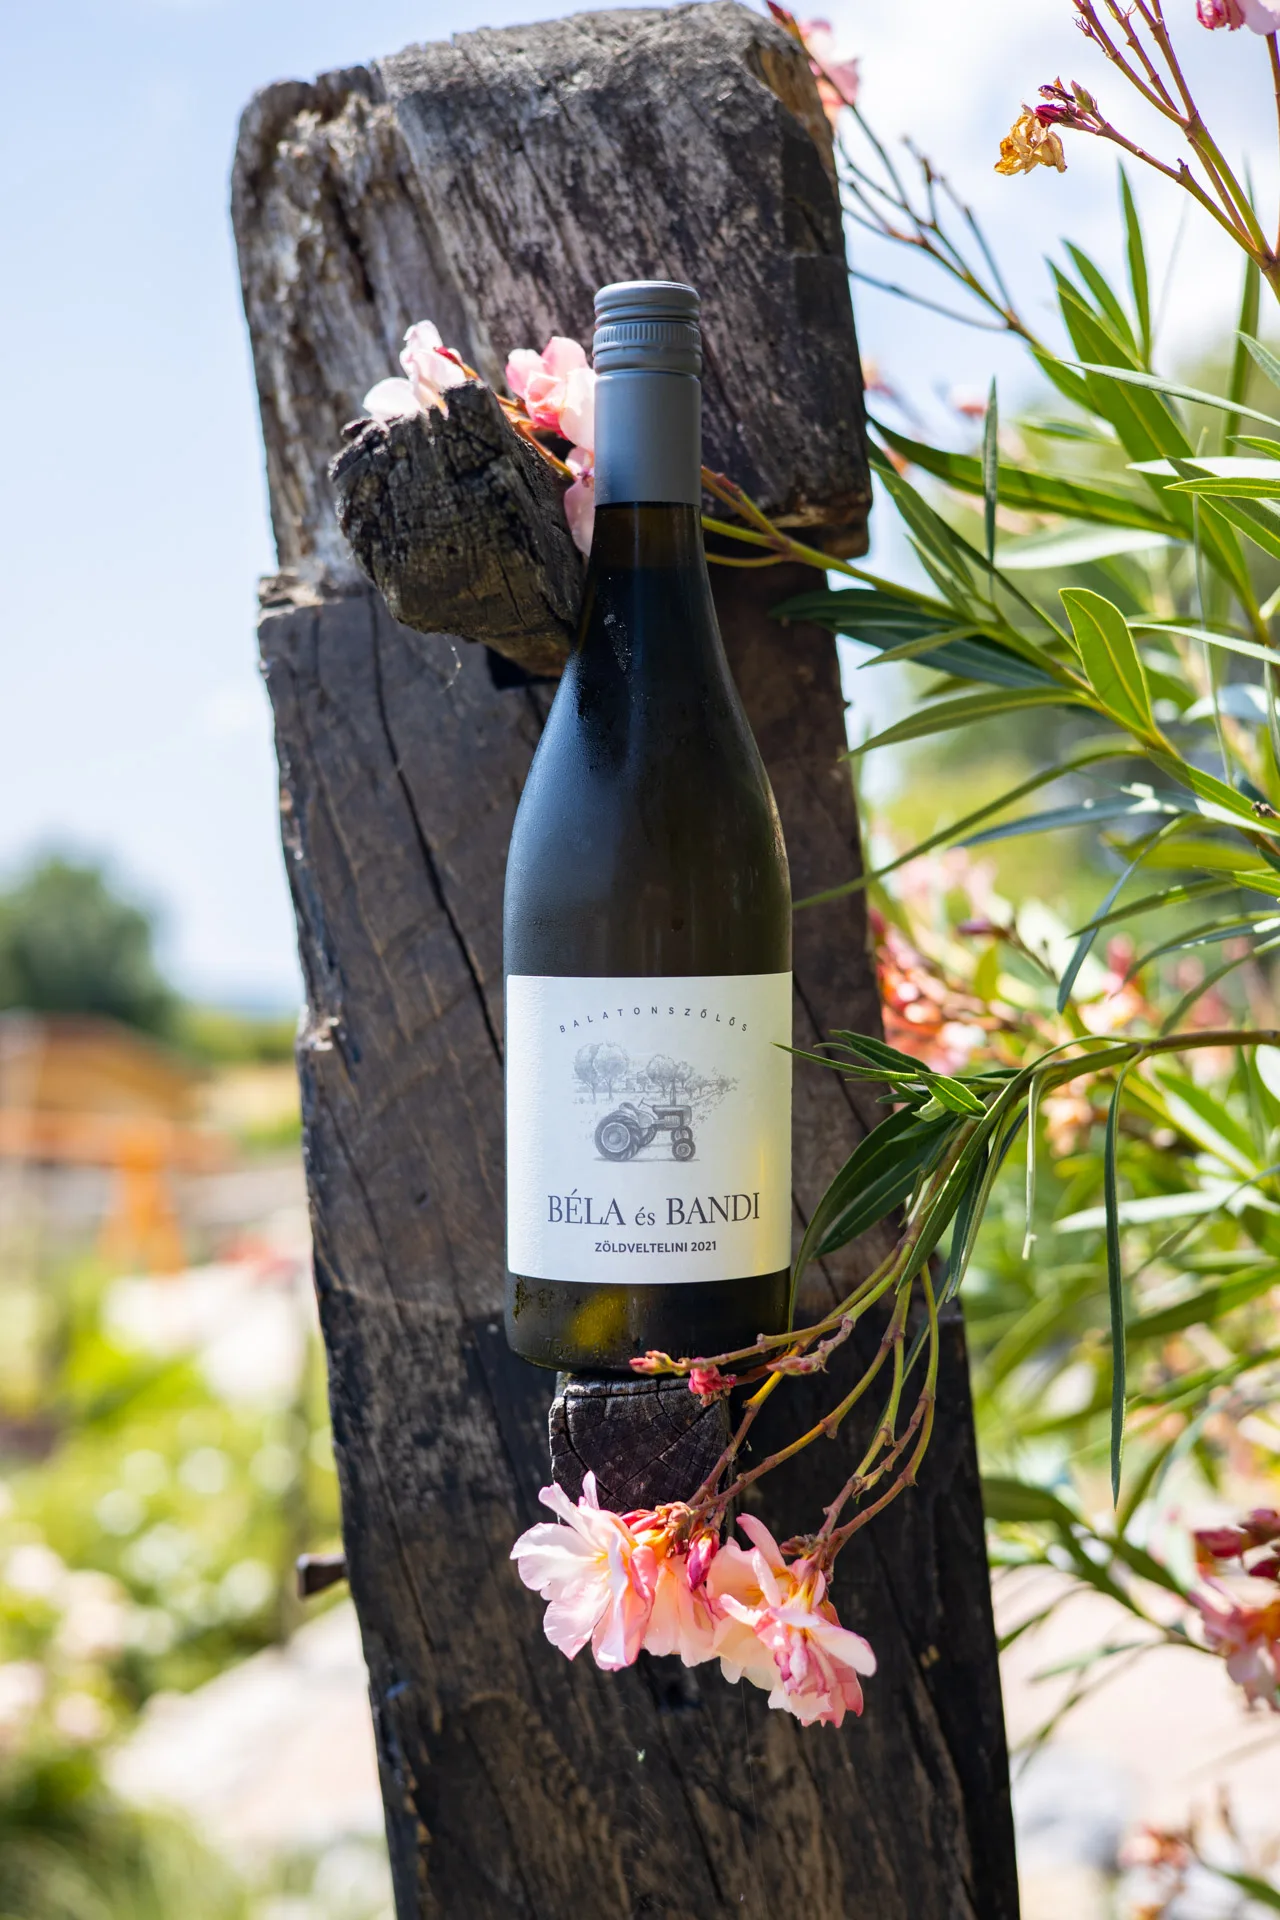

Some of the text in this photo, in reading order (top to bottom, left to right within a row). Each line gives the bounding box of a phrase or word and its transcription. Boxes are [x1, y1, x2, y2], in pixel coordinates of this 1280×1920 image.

[547, 1188, 760, 1226] BÉLA és BANDI
[594, 1240, 717, 1253] ZÖLDVELTELINI 2021
